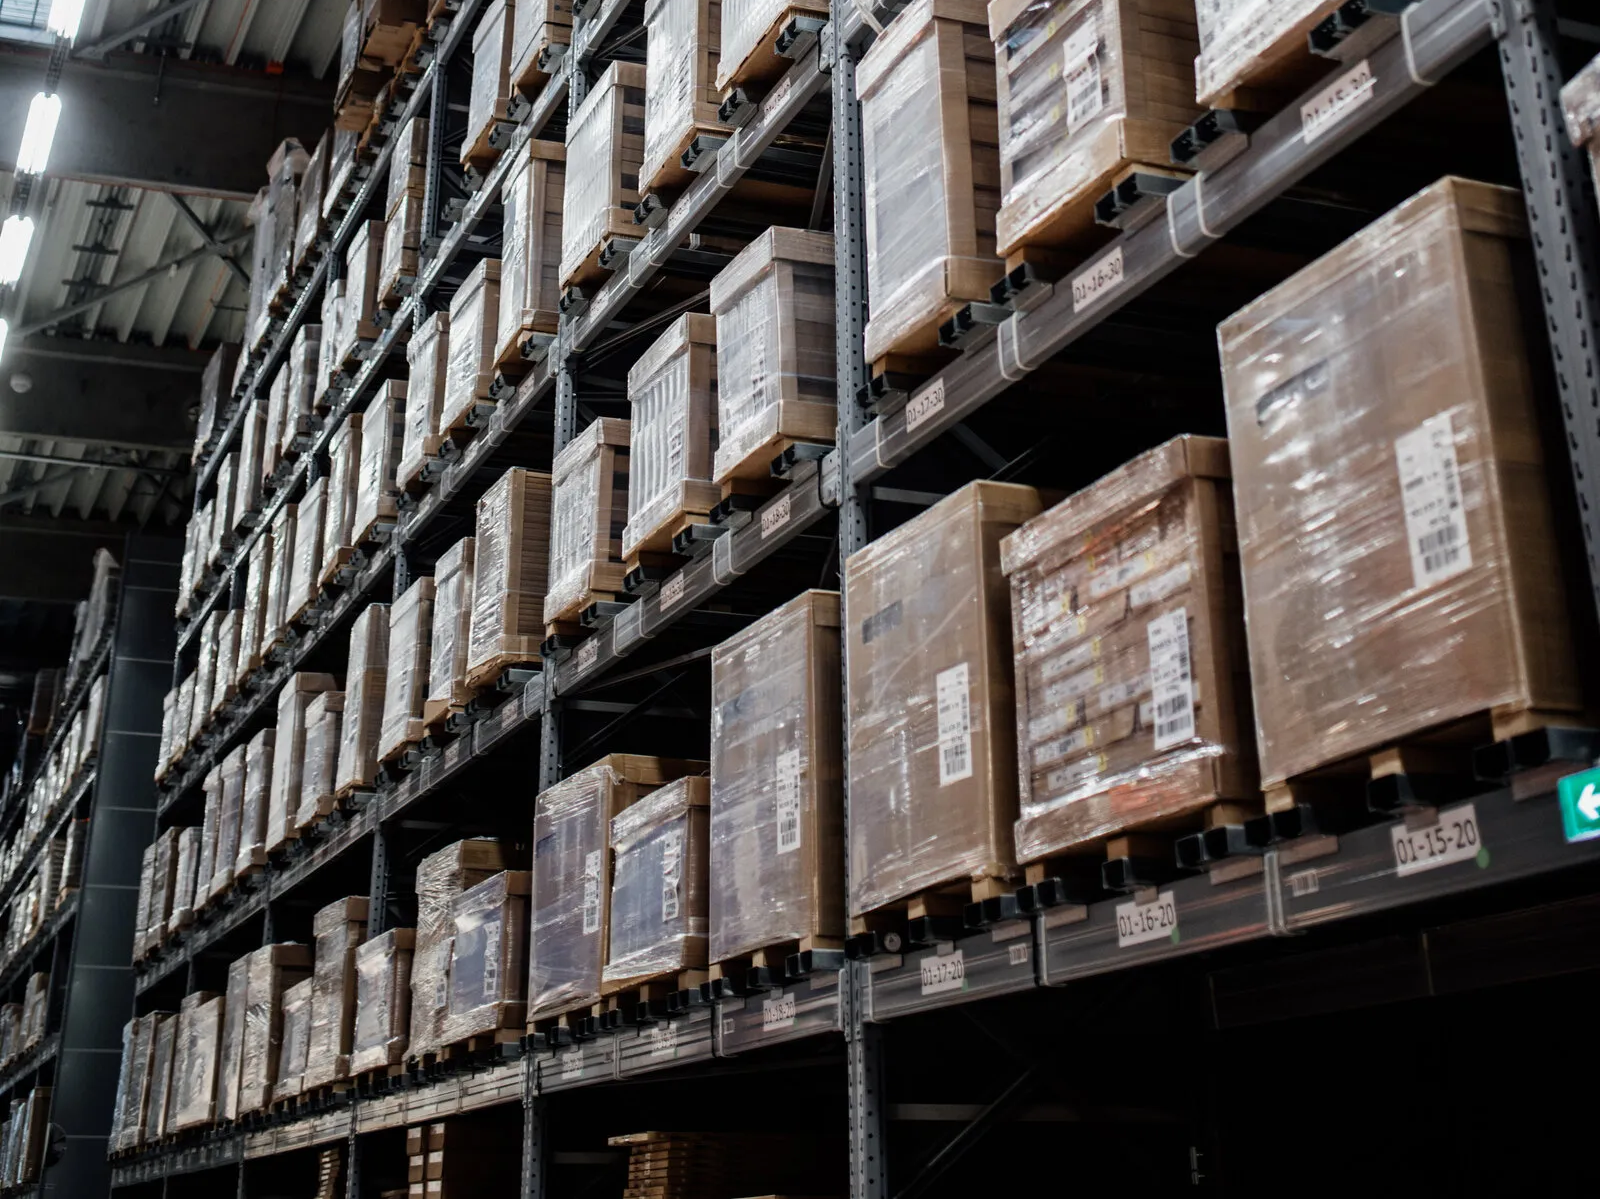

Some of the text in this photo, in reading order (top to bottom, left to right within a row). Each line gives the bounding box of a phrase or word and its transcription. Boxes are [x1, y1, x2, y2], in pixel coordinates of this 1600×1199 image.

[1075, 257, 1122, 305] 01-16-30
[907, 387, 944, 426] 01-17-30
[1396, 818, 1477, 865] 01-15-20
[1119, 902, 1175, 938] 01-16-20
[922, 960, 964, 987] 01-17-20
[763, 1001, 795, 1025] 01-18-20
